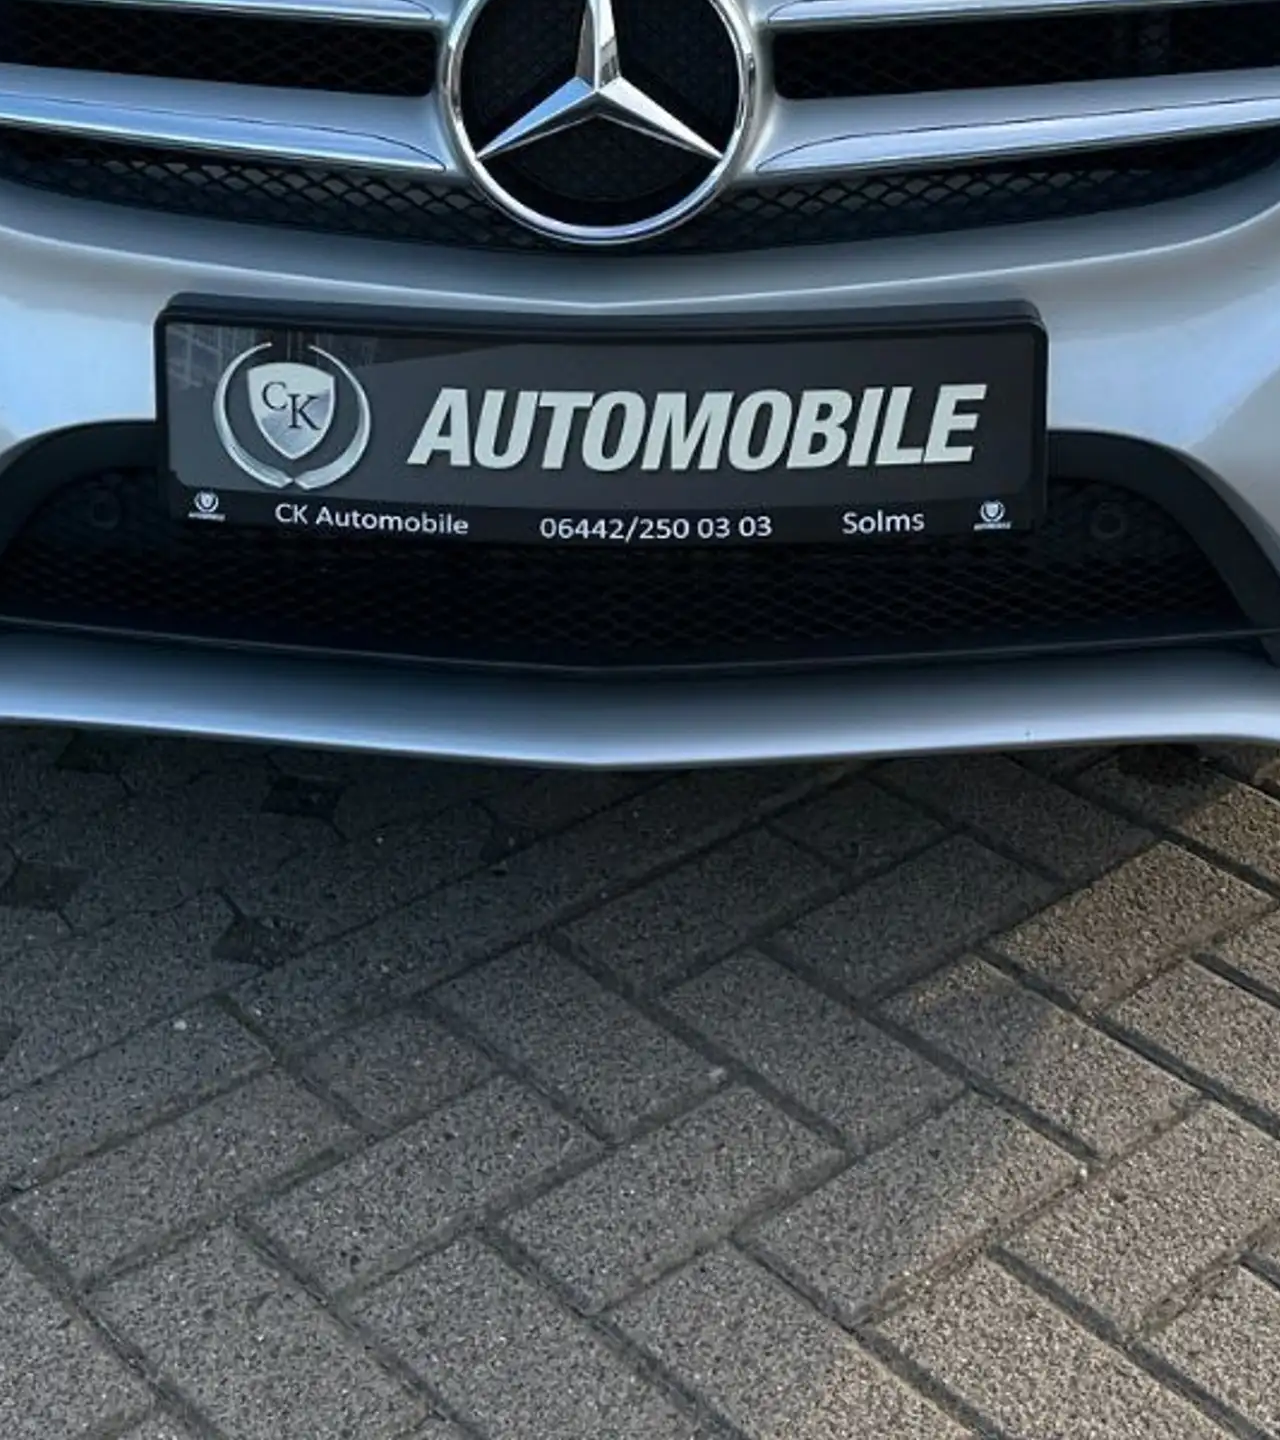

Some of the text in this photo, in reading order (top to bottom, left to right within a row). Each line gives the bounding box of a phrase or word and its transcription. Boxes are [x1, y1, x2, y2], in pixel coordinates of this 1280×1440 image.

[261, 381, 322, 432] CK
[406, 383, 988, 472] AUTOMOBILE
[275, 503, 469, 536] CK Automobile
[539, 515, 773, 543] 06442/250 03 03
[841, 509, 926, 534] Solms
